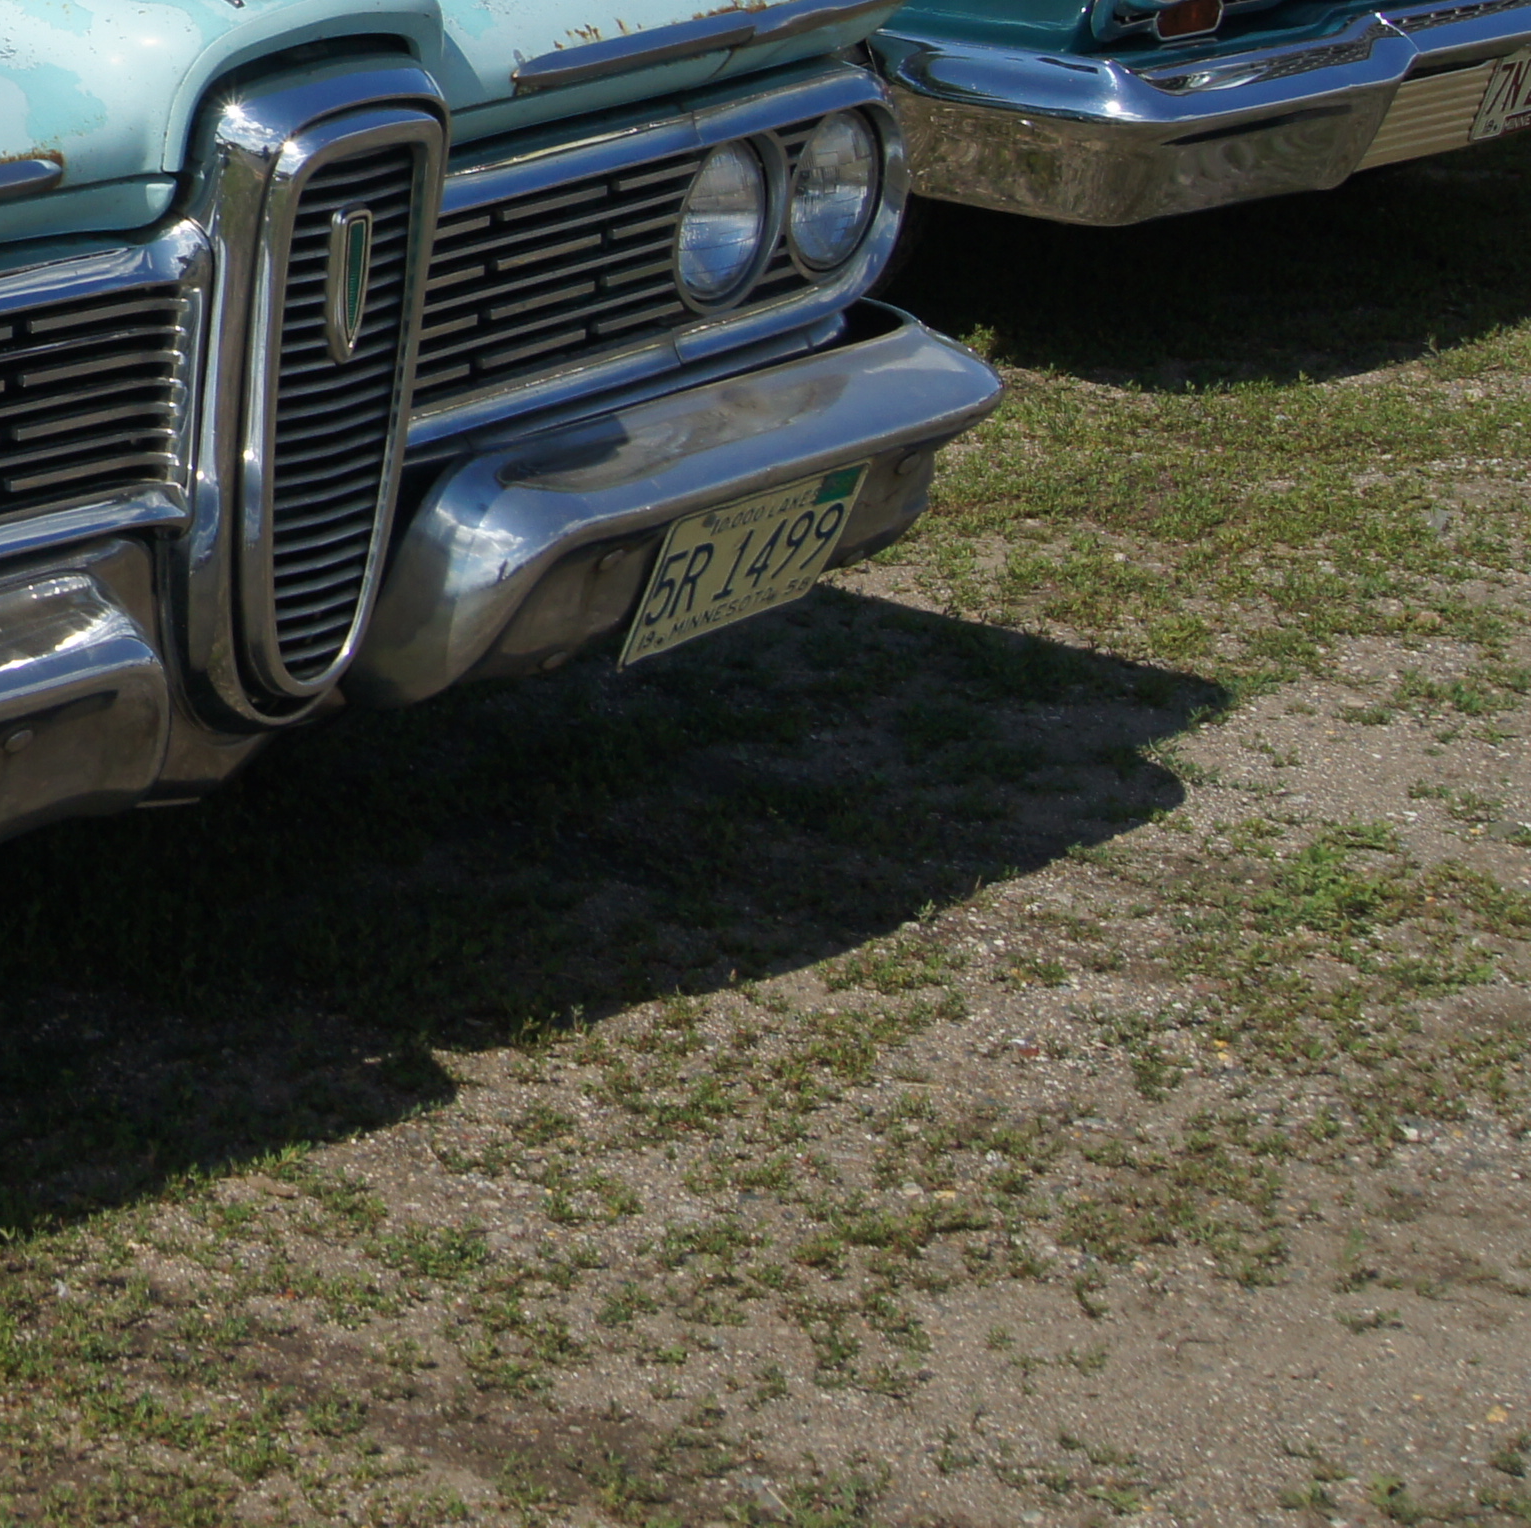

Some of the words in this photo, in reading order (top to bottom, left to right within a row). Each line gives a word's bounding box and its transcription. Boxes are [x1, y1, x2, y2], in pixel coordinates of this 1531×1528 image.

[1485, 60, 1531, 115] 7N
[645, 542, 714, 626] 5R
[711, 502, 844, 601] 1499
[669, 587, 773, 639] MINNESOTA
